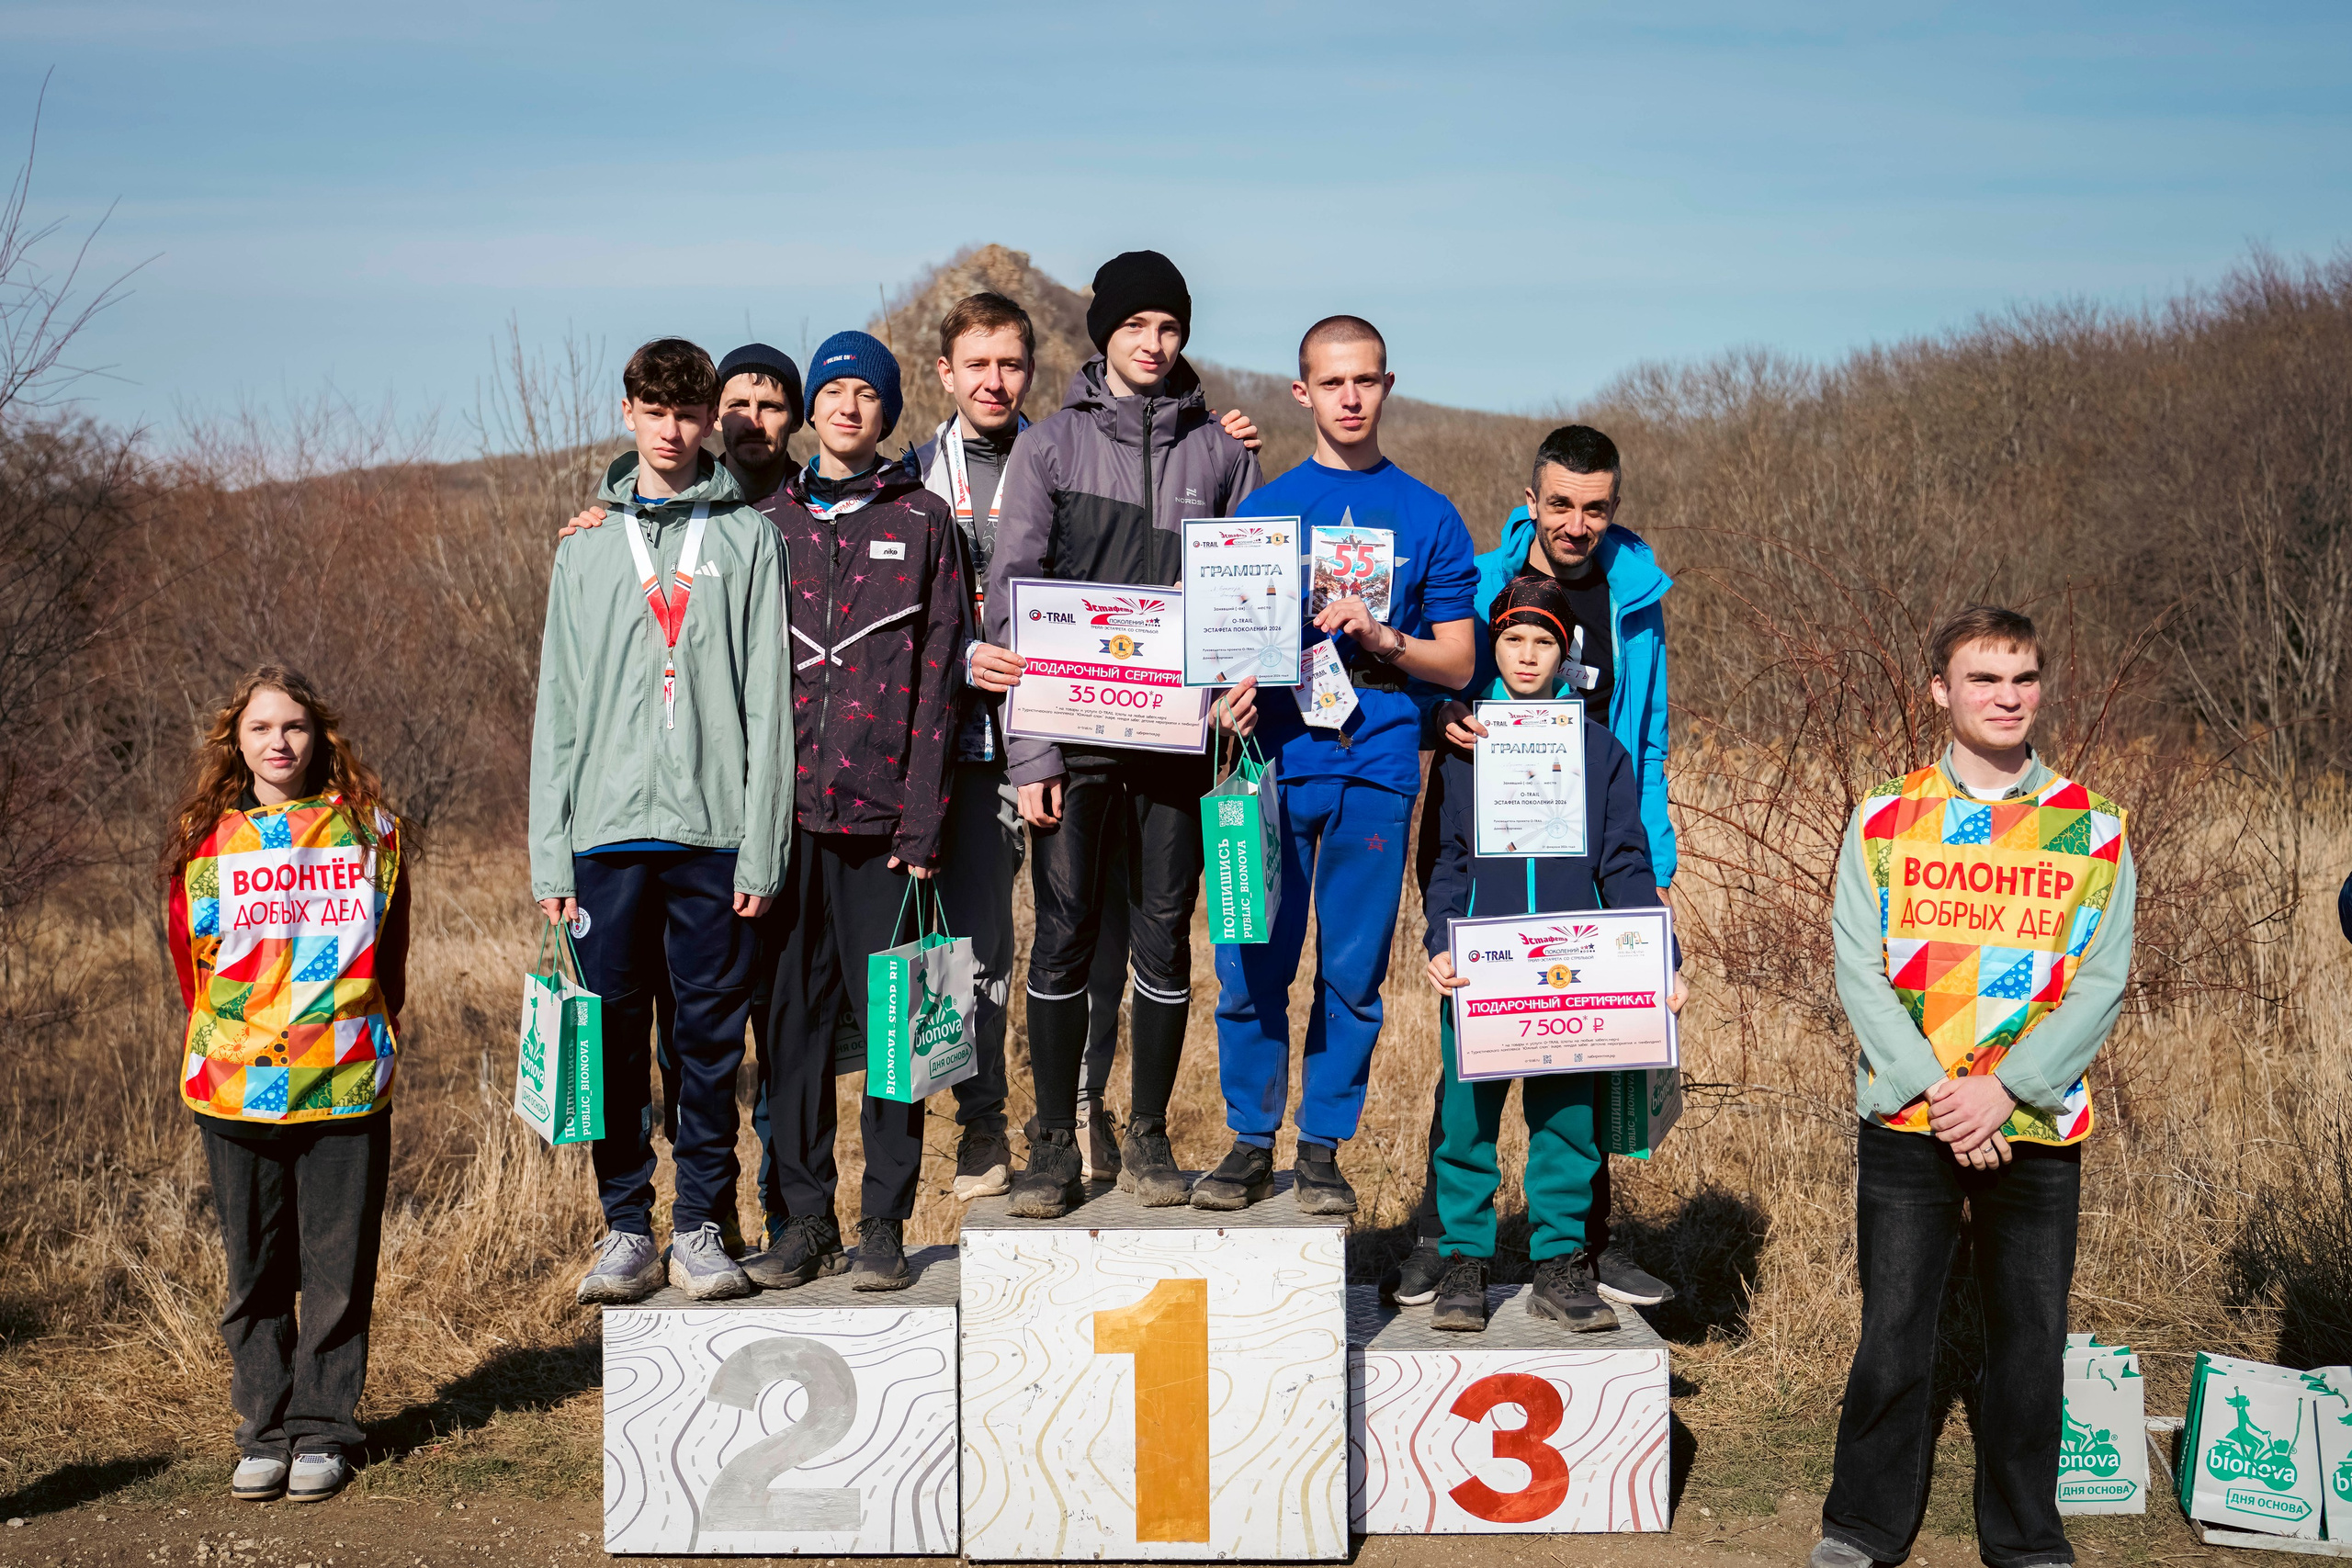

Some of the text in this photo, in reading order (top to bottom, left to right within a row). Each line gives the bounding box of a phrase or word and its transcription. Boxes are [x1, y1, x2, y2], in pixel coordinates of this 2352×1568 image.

[827, 355, 843, 365] VOLUME
[1200, 564, 1283, 578] ГРАМОТА
[1332, 545, 1374, 578] 55
[1029, 609, 1076, 625] O-TRAIL
[1081, 598, 1134, 614] Эстафета
[1030, 660, 1119, 679] ПОДАРОЧНЫЙ
[1069, 684, 1095, 703] 35
[1490, 743, 1567, 754] ГРАМОТА
[233, 857, 364, 896] ВООНТЁР
[1218, 838, 1236, 939] ПОДПИШИСЬ
[1238, 840, 1253, 939] PUBLIC_BIONOVA
[1904, 857, 2074, 900] ВОЛОНТЁР
[233, 898, 367, 931] ДОБЫХ ДЕЛ
[1901, 897, 2064, 940] ДОБРЫХ ДЕЛ
[1518, 932, 1568, 945] Эстафета
[1544, 947, 1579, 955] ПОКОЛЕНИЙ
[1468, 950, 1513, 963] O-TRAIL
[1472, 994, 1652, 1014] ПОДАРОЧНЫЙ СЕРТИФИКАТ
[886, 960, 898, 1096] BIONOVA-SHOP.RU
[915, 1018, 963, 1048] bionova
[1519, 1020, 1532, 1037] 7
[932, 1048, 969, 1073] ДНЯ ОСНОВА
[564, 1039, 576, 1138] ПОДПИШИСЬ
[581, 1039, 593, 1136] PUBLIC_BIONOVA
[1094, 1279, 1210, 1543] 1
[701, 1336, 861, 1531] 2
[1448, 1372, 1570, 1523] 3
[2210, 1449, 2297, 1483] bionova
[2063, 1484, 2130, 1496] ДНЯ ОСНОВА
[2230, 1493, 2303, 1514] ДНЯ ОСНОВА
